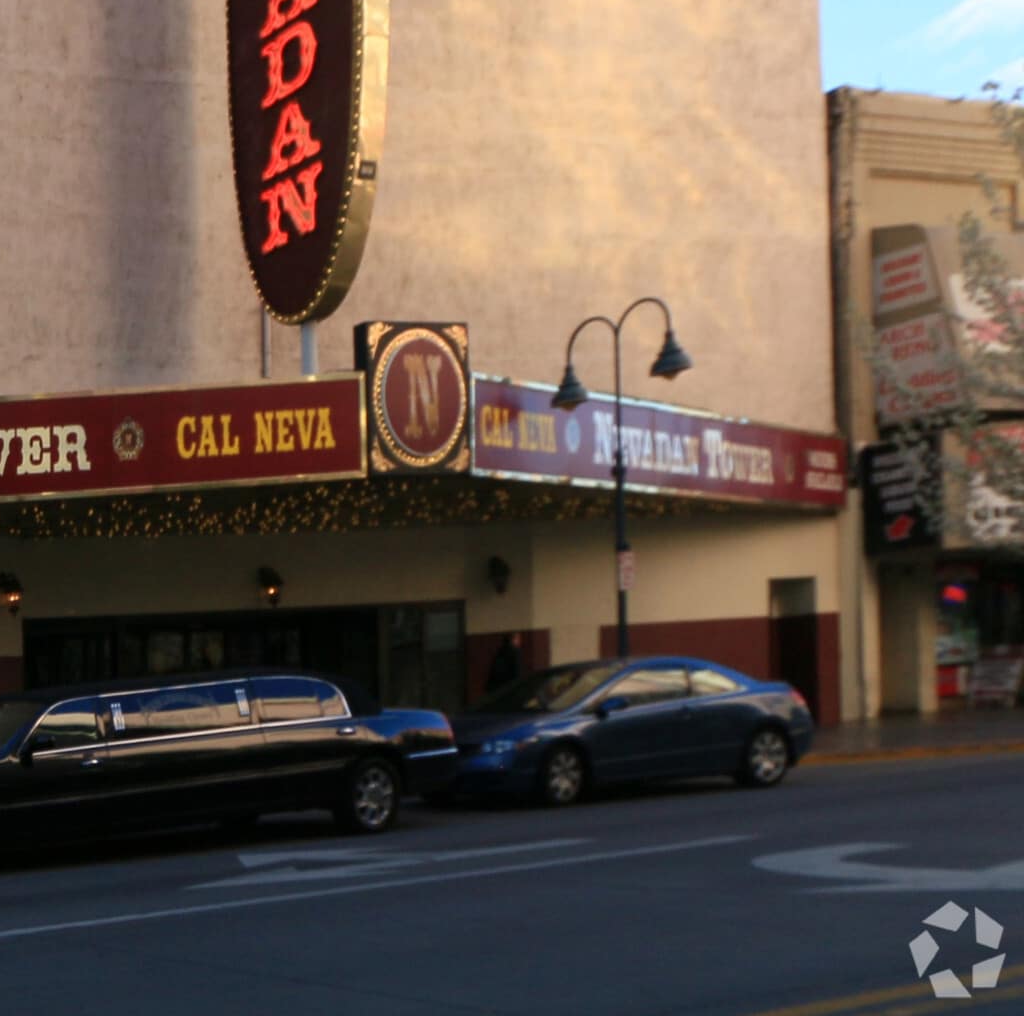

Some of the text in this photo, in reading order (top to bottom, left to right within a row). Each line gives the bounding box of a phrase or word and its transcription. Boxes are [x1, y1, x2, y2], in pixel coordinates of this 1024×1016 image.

[403, 353, 443, 439] N
[175, 407, 336, 459] CAL NEVA
[480, 405, 513, 448] CAL
[702, 428, 775, 485] TOWER
